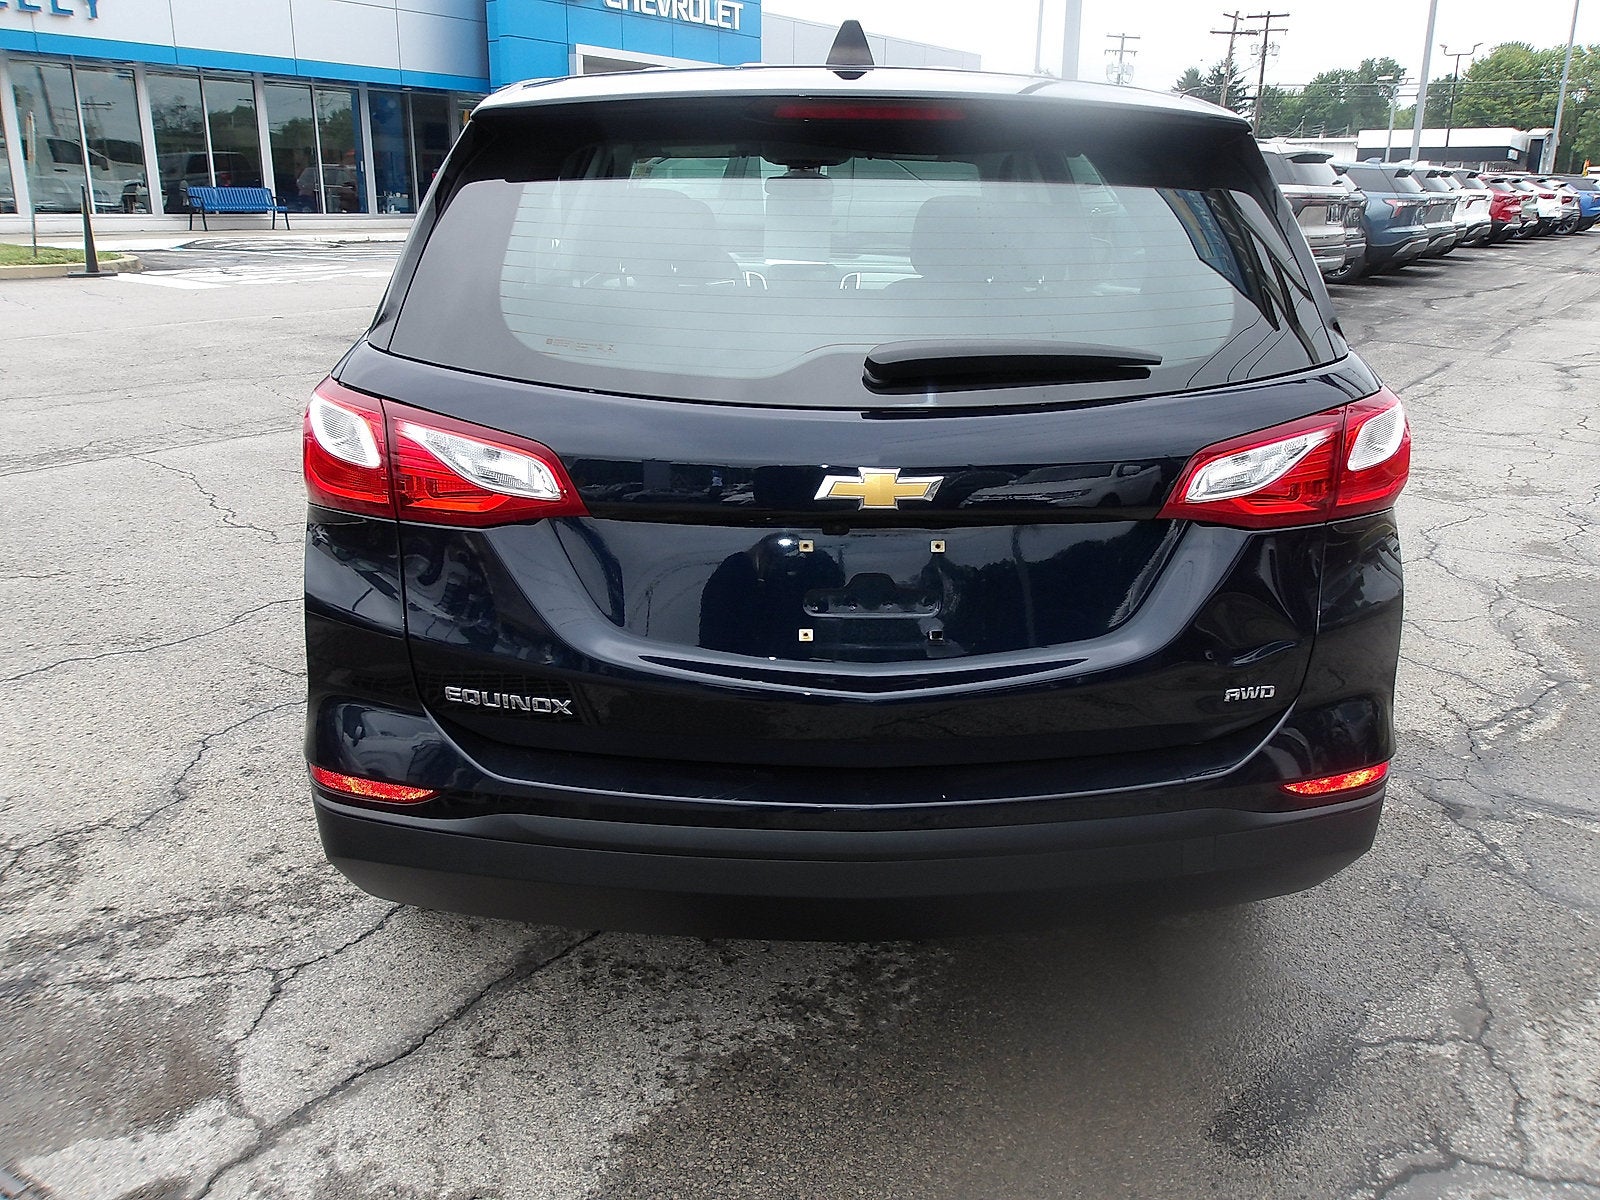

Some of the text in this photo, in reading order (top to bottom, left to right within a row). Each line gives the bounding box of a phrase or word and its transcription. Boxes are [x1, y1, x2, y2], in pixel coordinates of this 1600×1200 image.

[0, 0, 98, 20] LLY
[444, 686, 573, 715] EQUINOX
[1224, 685, 1275, 702] AWD
